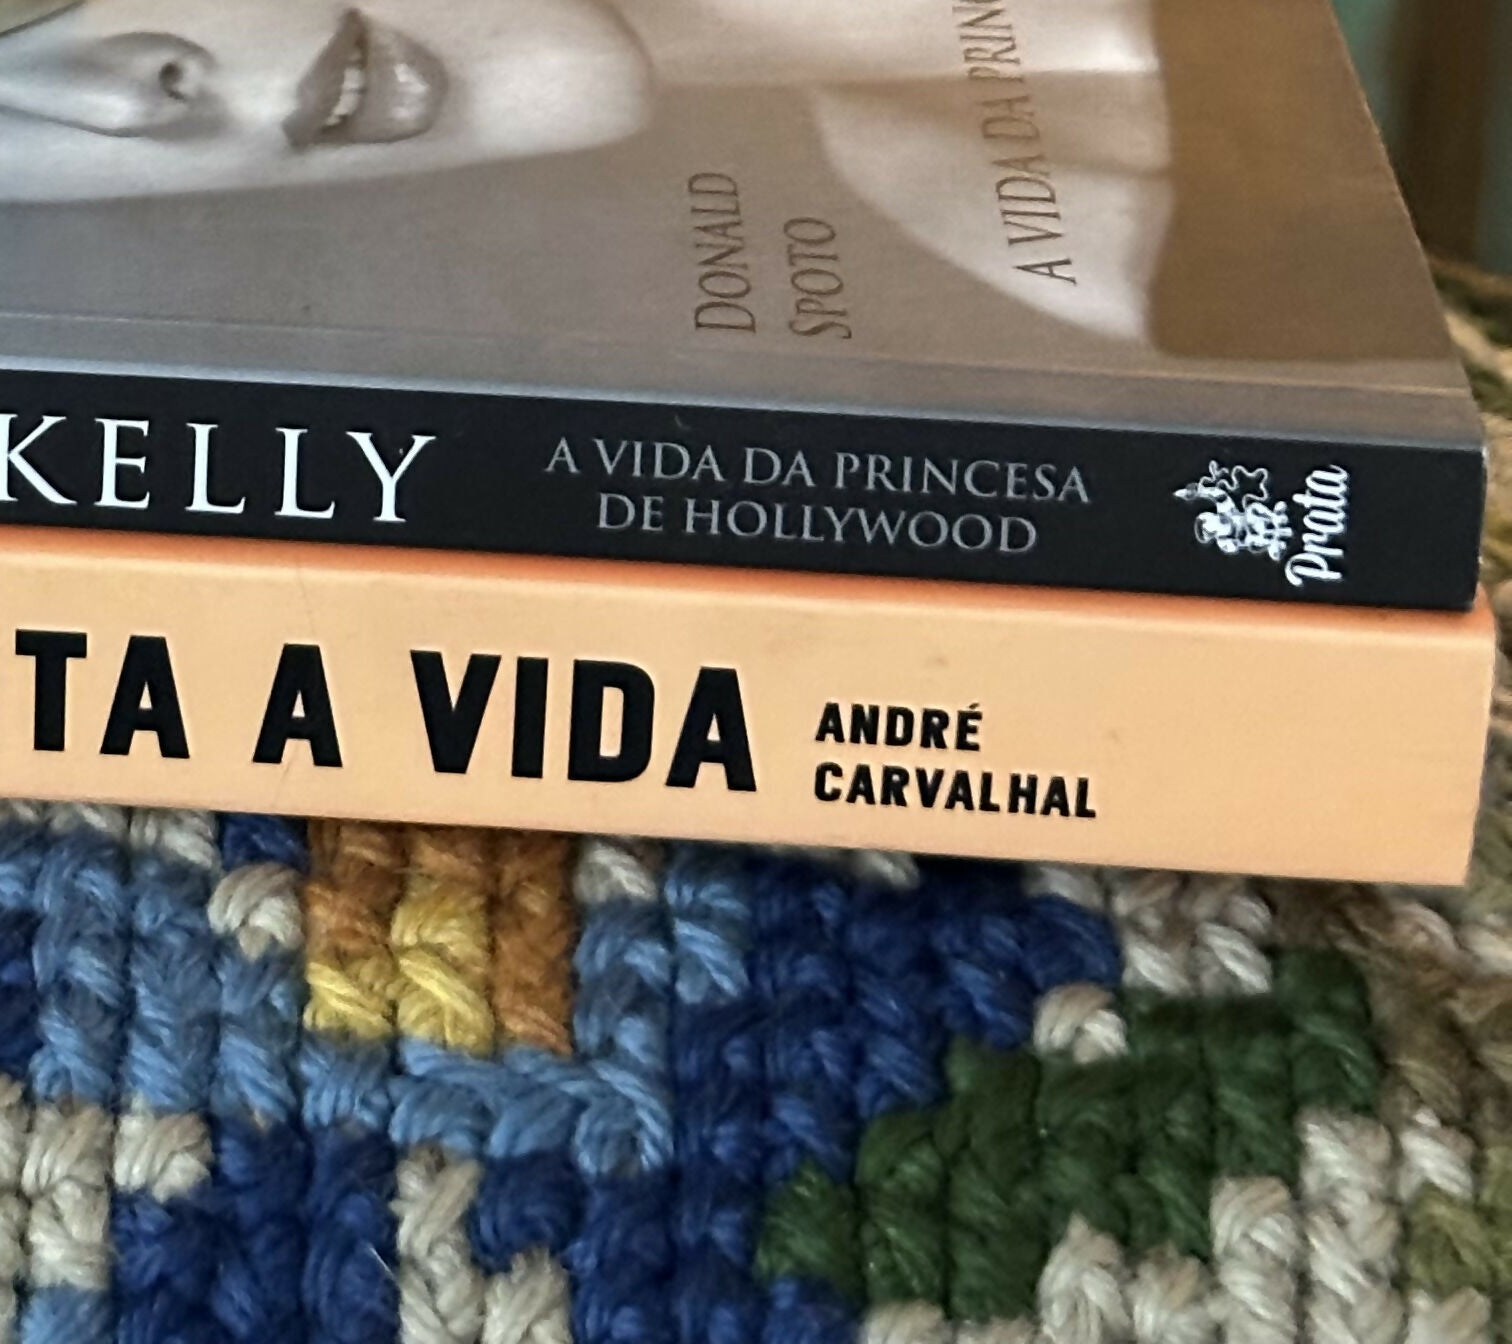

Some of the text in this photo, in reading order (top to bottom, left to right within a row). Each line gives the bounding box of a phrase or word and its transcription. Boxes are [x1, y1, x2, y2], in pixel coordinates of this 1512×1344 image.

[978, 93, 1041, 141] DA
[990, 153, 1065, 248] VIDA
[687, 171, 757, 335] DONALD
[783, 216, 853, 340] SPOTO
[1011, 257, 1078, 287] A
[543, 436, 1091, 506] A VIDA DA PRINCESA
[597, 492, 1039, 555] DE HOLLYWOOD
[1285, 463, 1349, 588] Prata
[251, 642, 344, 768] A
[409, 648, 758, 793] VIDA
[814, 701, 985, 752] ANDRÉ
[813, 760, 1098, 819] CARVALHAL
